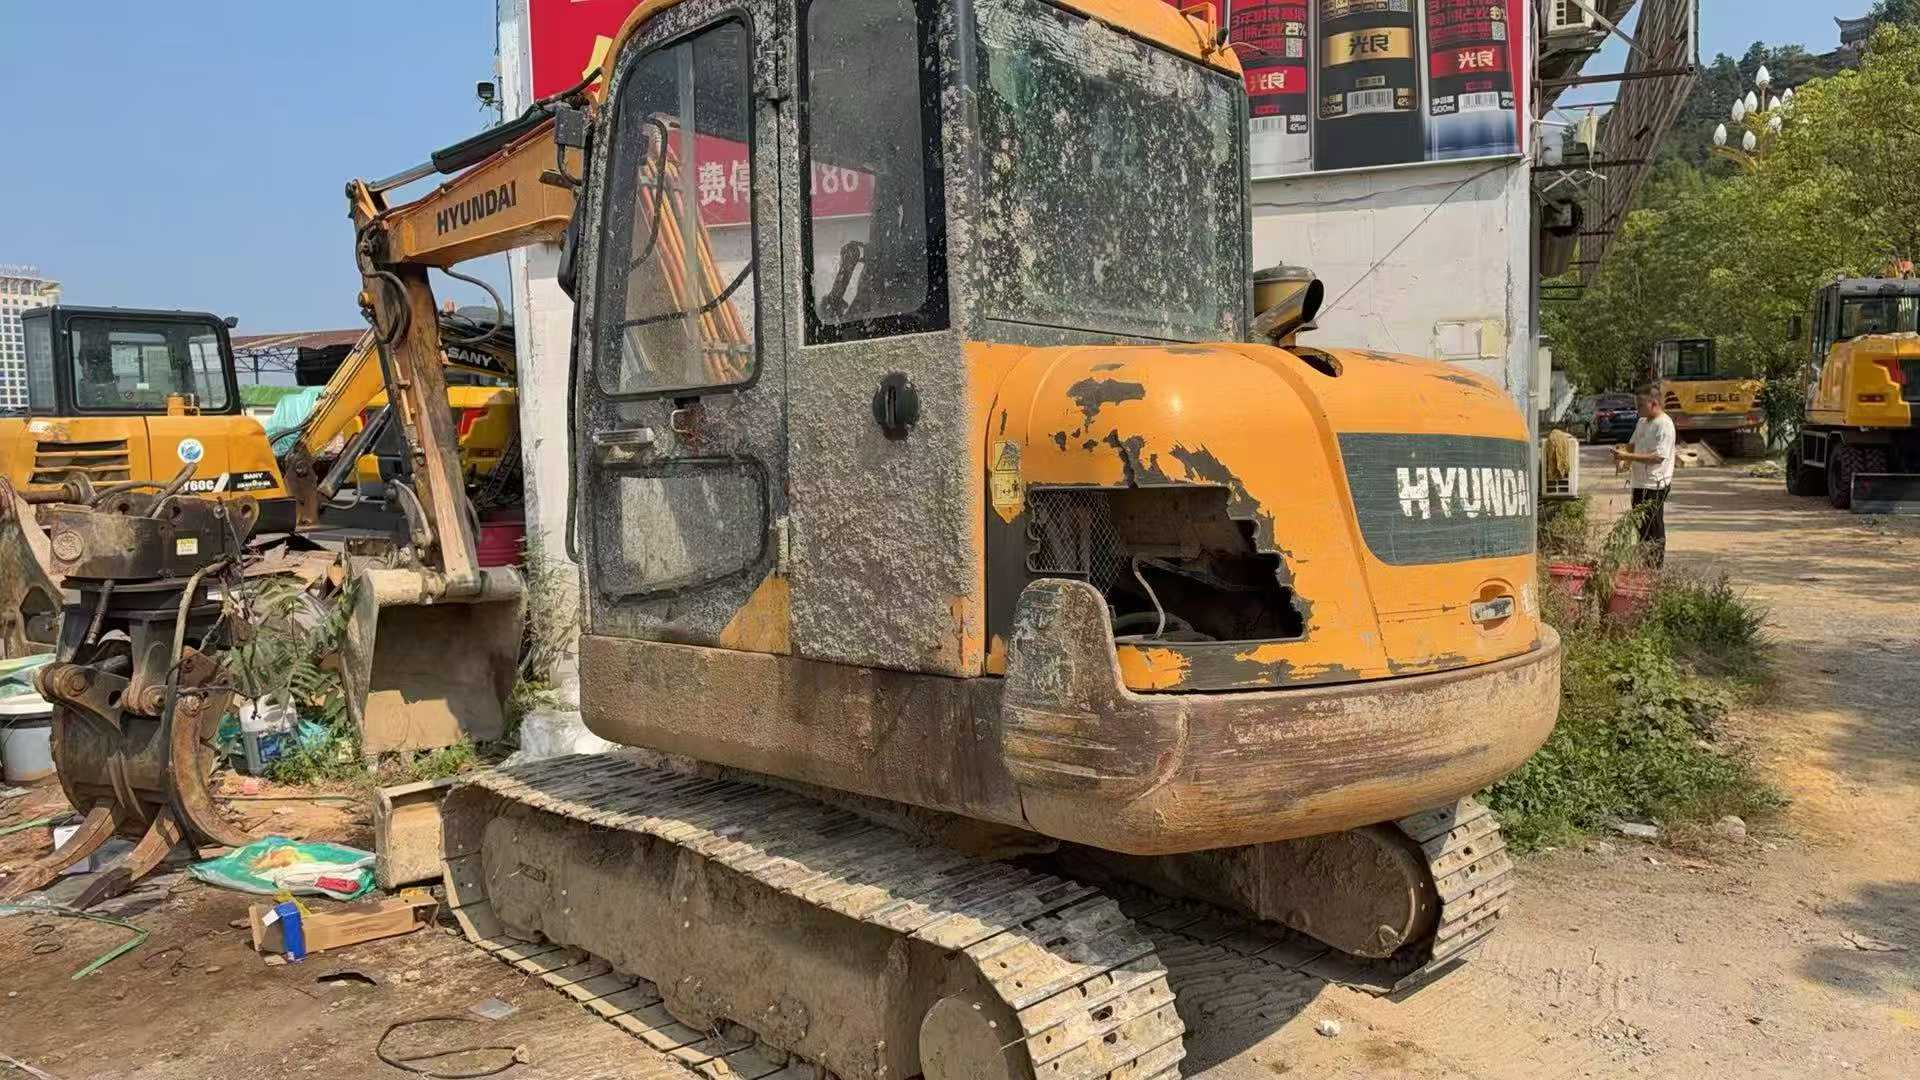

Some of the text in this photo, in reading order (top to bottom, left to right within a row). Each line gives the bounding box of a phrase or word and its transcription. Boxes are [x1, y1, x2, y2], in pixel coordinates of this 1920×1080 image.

[1349, 33, 1389, 56] 光良
[1458, 50, 1494, 69] 光良
[1248, 71, 1286, 92] 光良
[437, 180, 517, 236] HYUNDAI
[448, 347, 493, 367] SANY
[182, 479, 214, 492] Y60C
